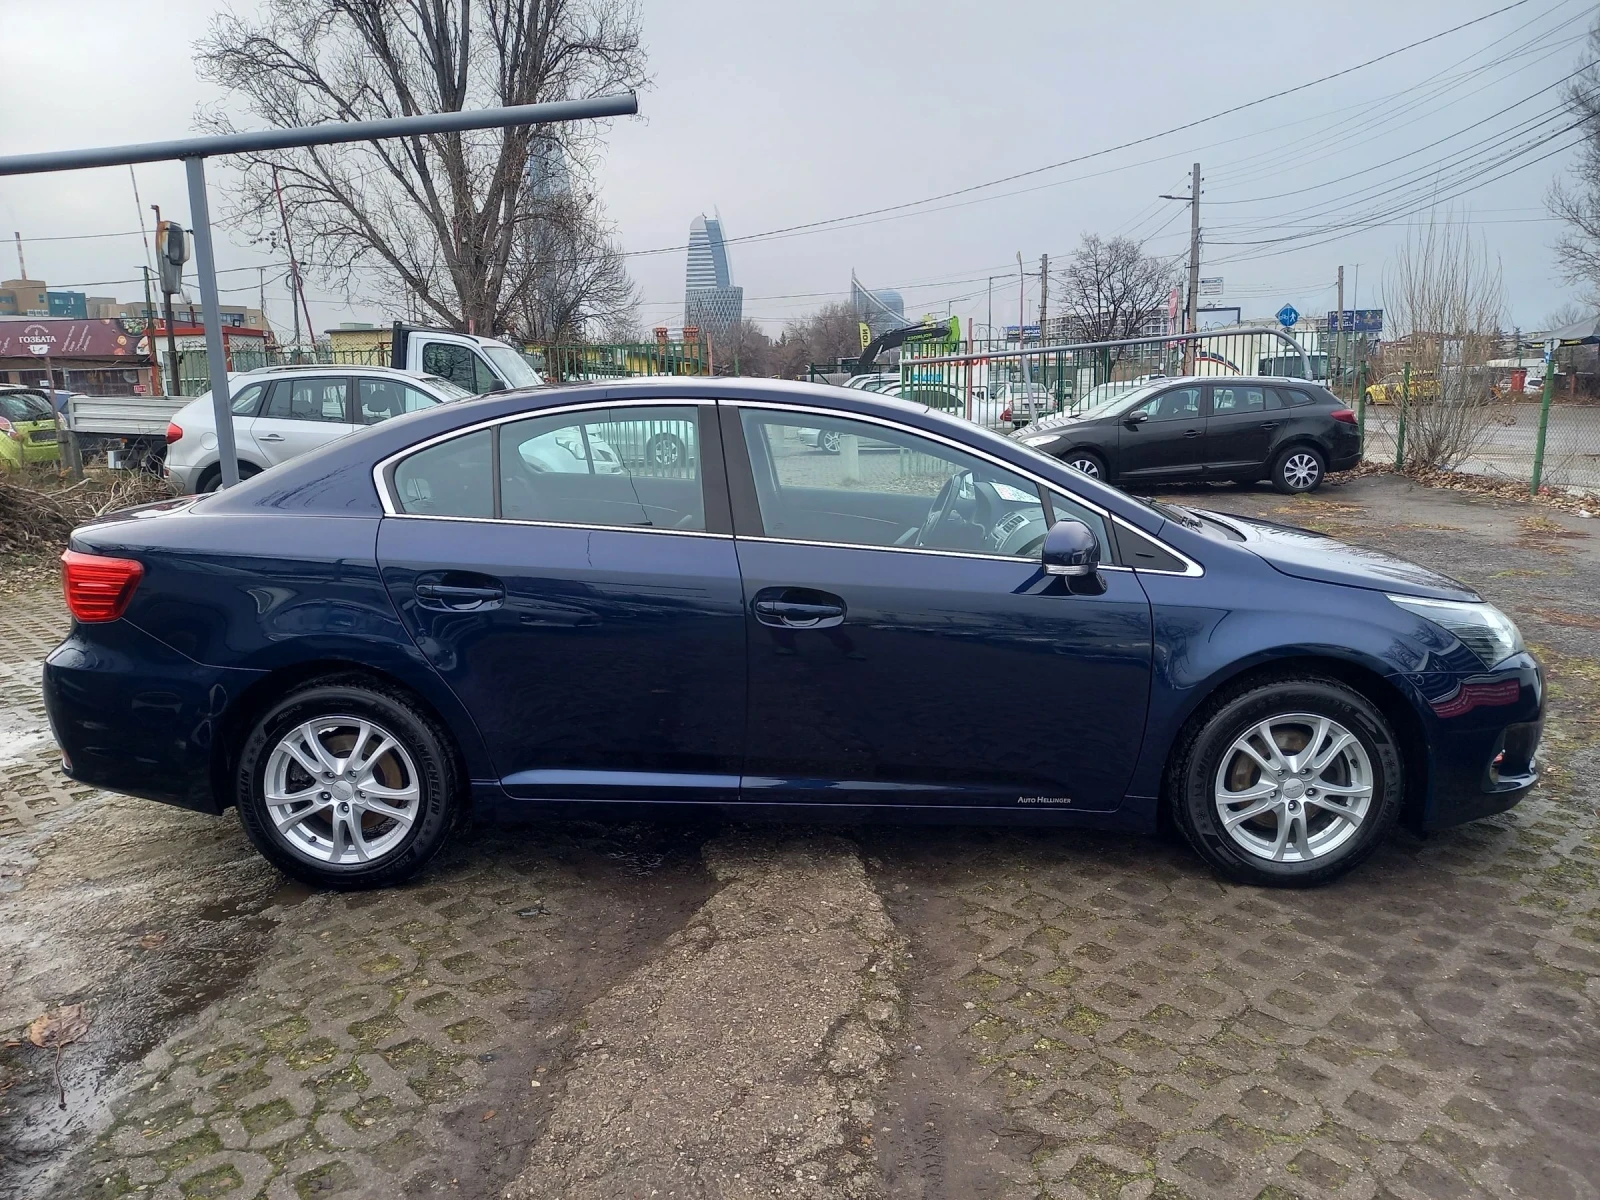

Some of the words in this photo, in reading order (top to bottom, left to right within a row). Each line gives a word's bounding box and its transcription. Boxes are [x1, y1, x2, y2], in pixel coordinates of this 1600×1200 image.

[18, 335, 57, 344] ГОЗБАТА
[416, 743, 441, 816] MICHELIN
[1017, 796, 1036, 804] AUTO
[1037, 796, 1071, 804] HELLINGER
